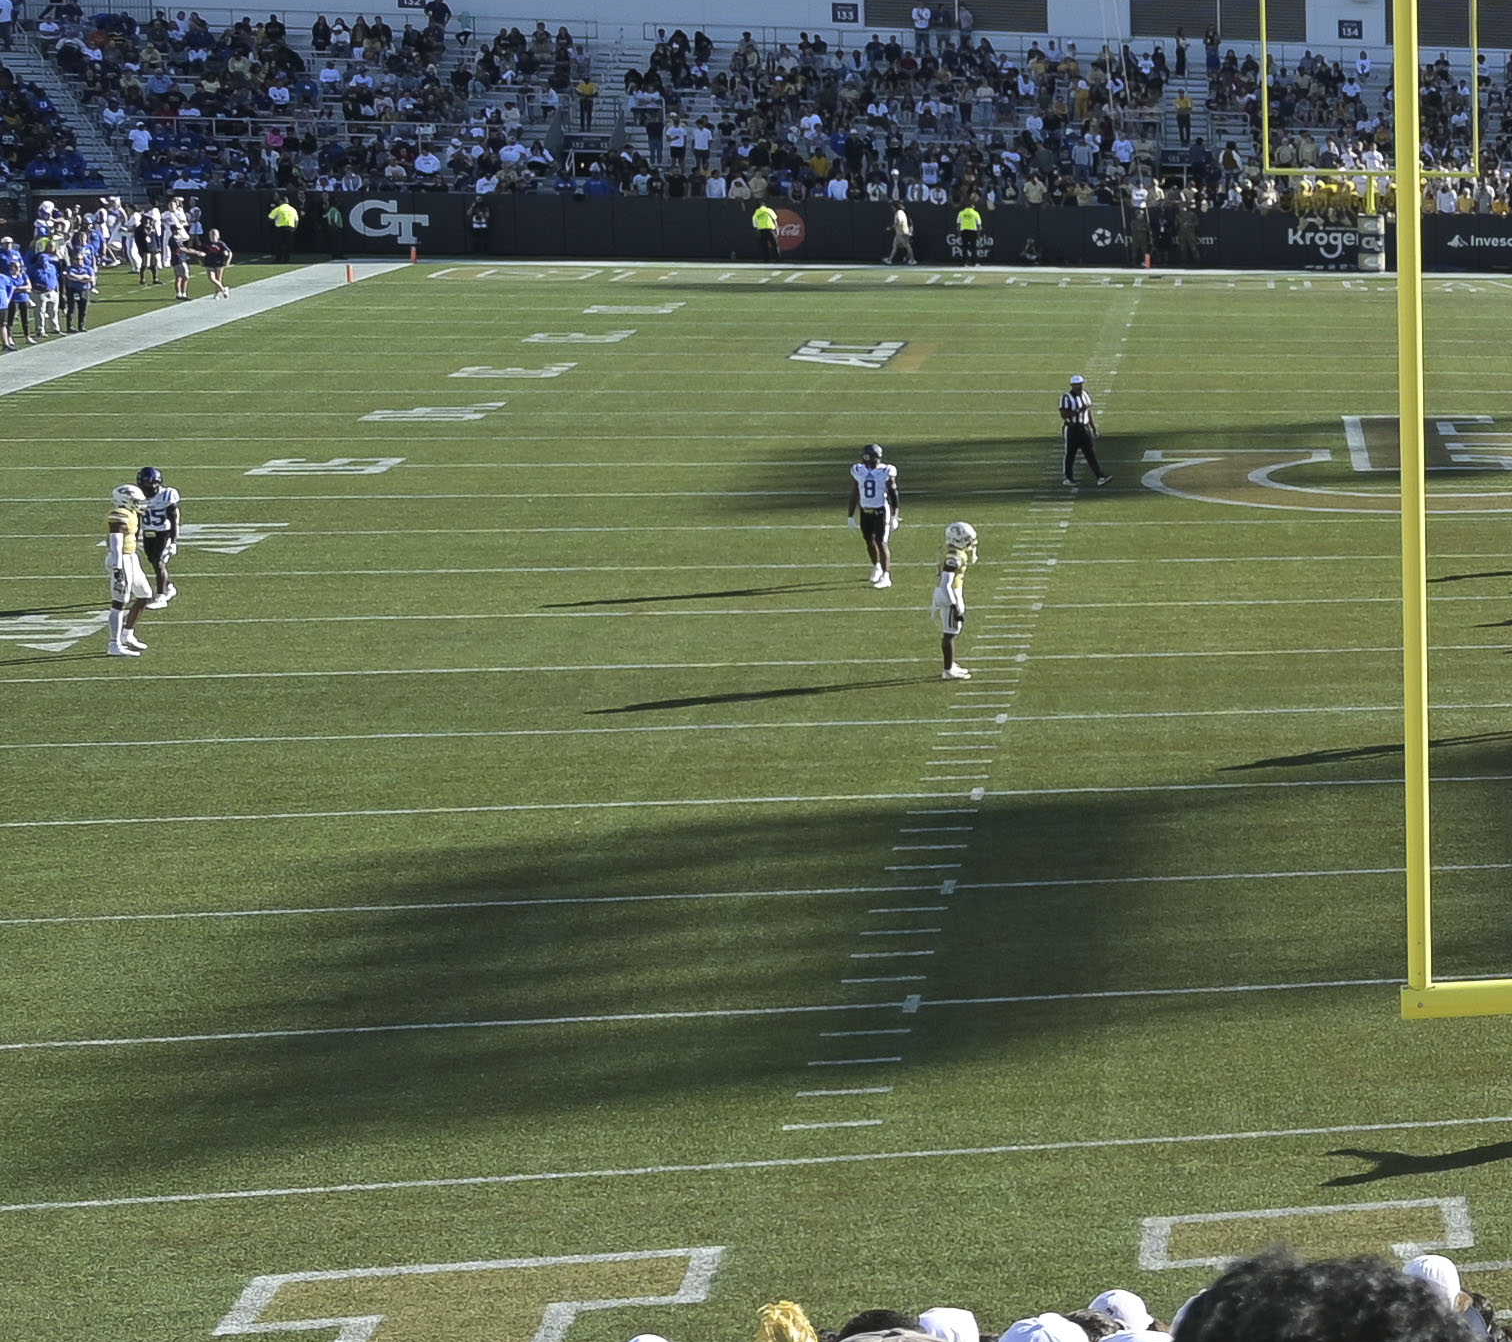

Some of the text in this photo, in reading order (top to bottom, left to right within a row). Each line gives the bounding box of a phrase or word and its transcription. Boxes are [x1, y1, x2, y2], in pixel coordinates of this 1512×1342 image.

[837, 10, 854, 20] 133
[1288, 228, 1358, 258] Kroge
[863, 479, 876, 499] 8
